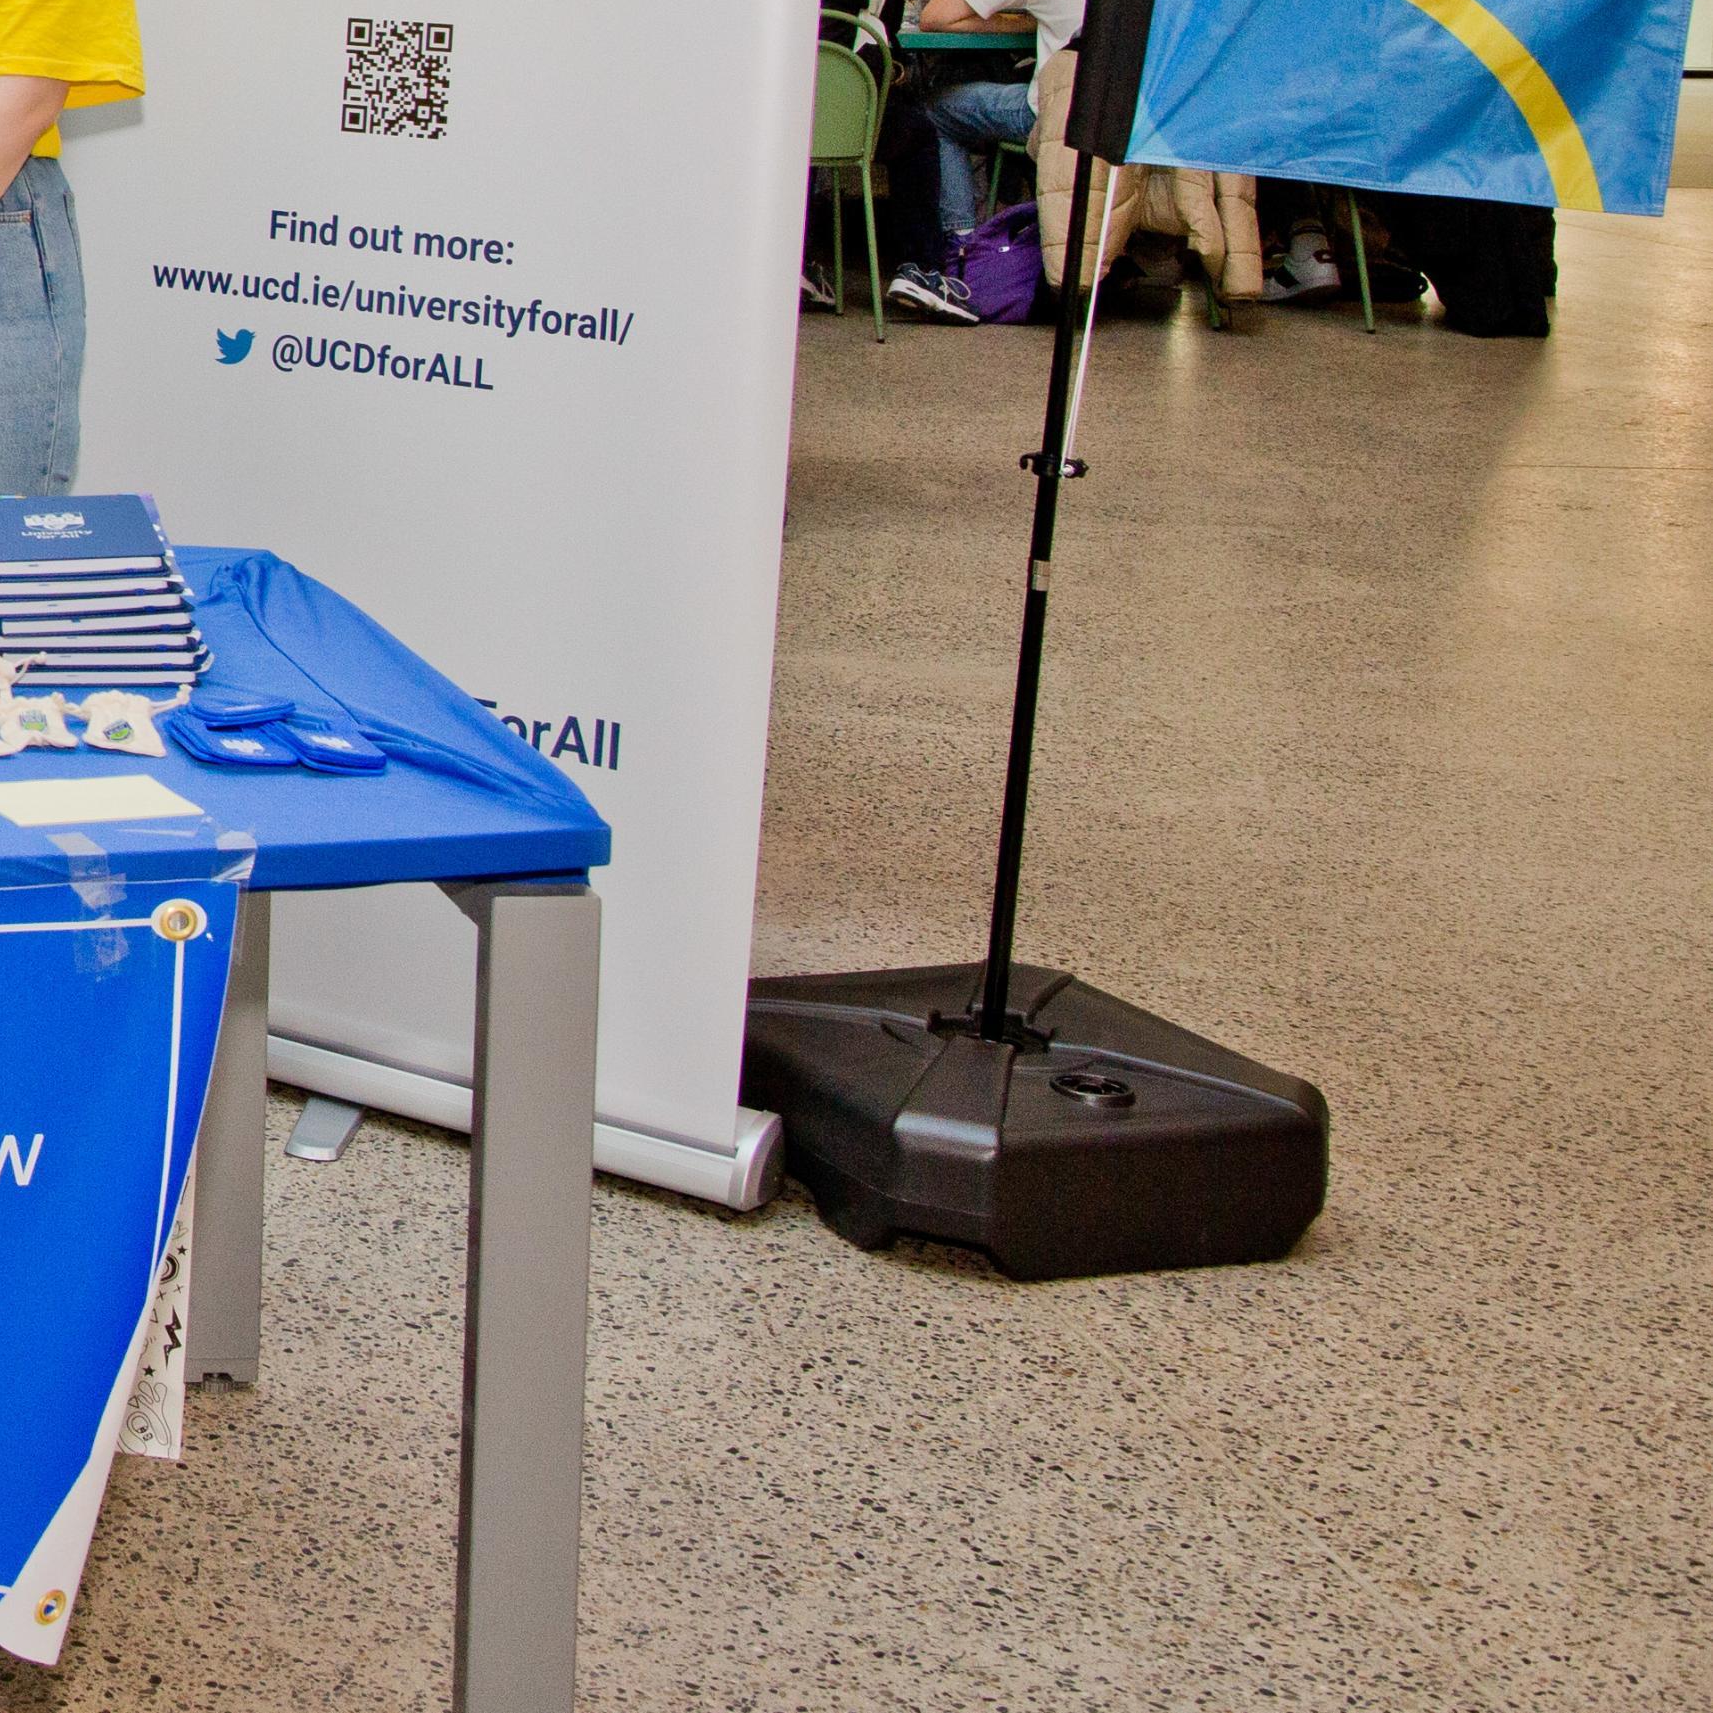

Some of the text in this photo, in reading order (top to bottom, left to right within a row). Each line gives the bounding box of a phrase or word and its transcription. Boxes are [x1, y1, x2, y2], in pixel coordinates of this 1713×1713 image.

[268, 209, 515, 267] Find out more:
[152, 263, 634, 346] www.ucd.ie/universityforall/
[271, 333, 494, 391] @UCDforALL
